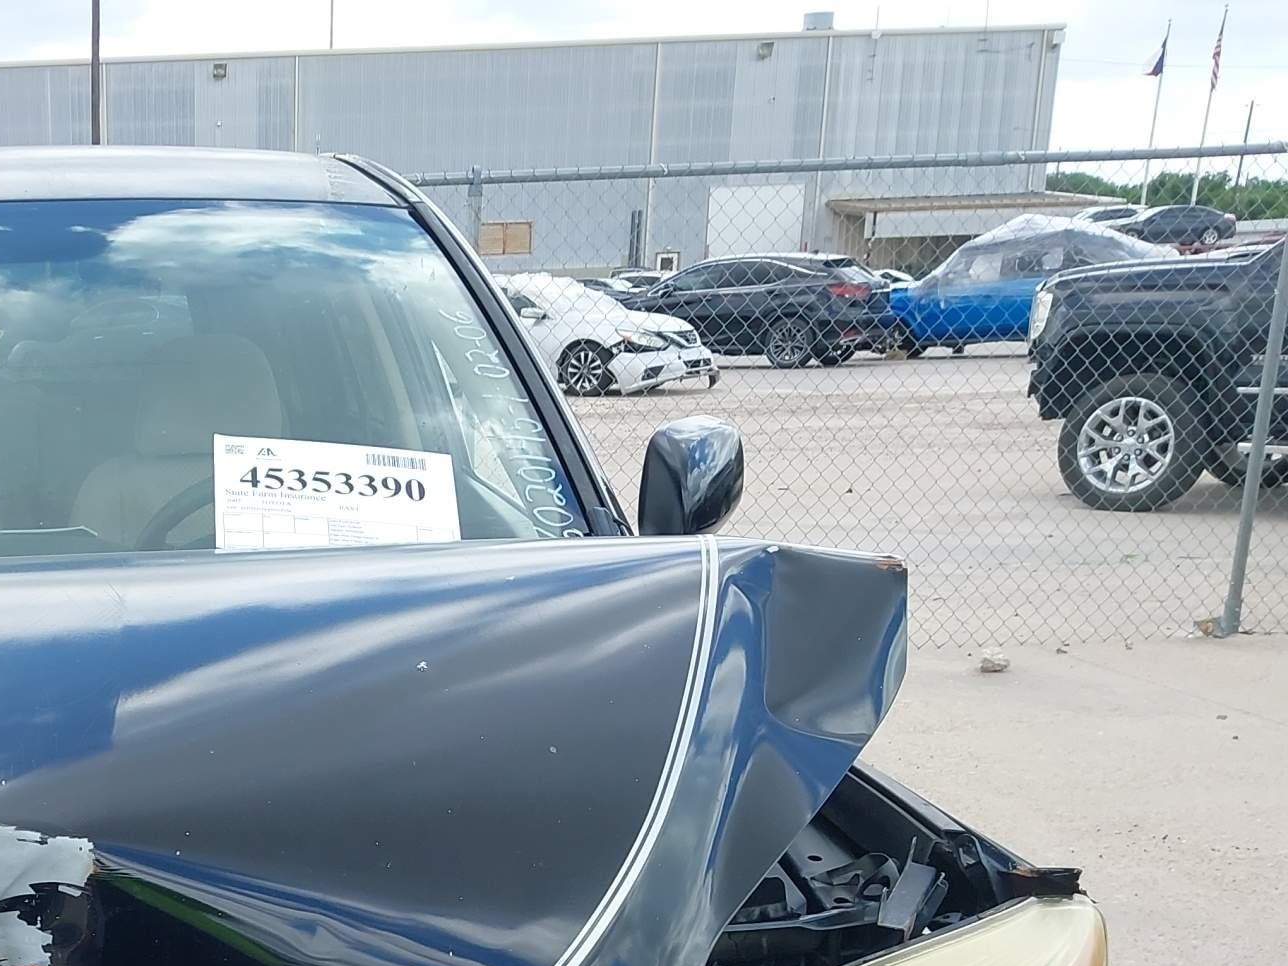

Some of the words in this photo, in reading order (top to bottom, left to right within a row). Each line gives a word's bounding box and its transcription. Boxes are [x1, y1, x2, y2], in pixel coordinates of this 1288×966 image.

[225, 488, 249, 497] State
[252, 490, 277, 498] Farm
[280, 491, 327, 502] Insurance
[239, 466, 426, 502] 45353390
